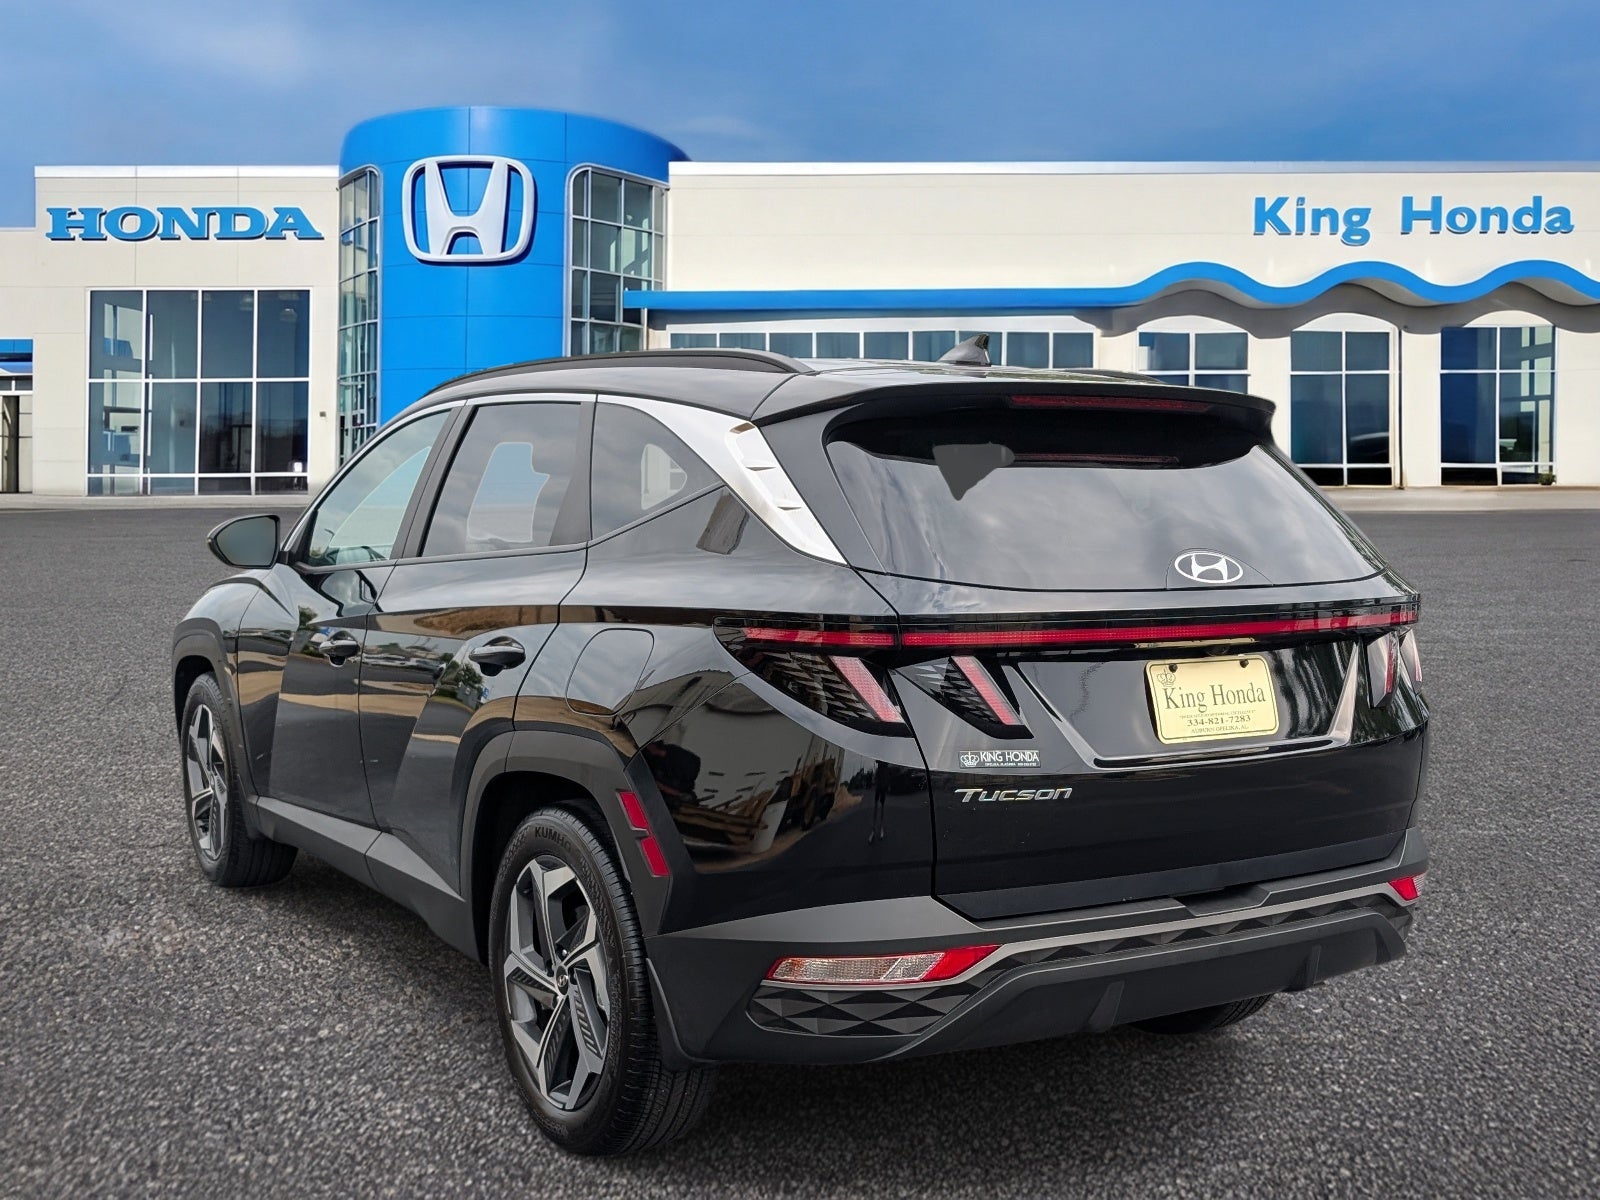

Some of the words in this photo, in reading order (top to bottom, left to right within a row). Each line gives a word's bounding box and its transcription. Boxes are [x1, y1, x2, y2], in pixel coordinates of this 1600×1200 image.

[46, 206, 325, 241] HONDA
[1253, 196, 1372, 246] King
[1401, 195, 1575, 235] Honda
[1163, 687, 1206, 713] King
[1209, 682, 1266, 706] Honda
[1187, 714, 1251, 727] 334-821-7283
[980, 750, 1003, 762] KING
[1005, 750, 1040, 762] HONDA
[534, 826, 572, 853] KUMHO
